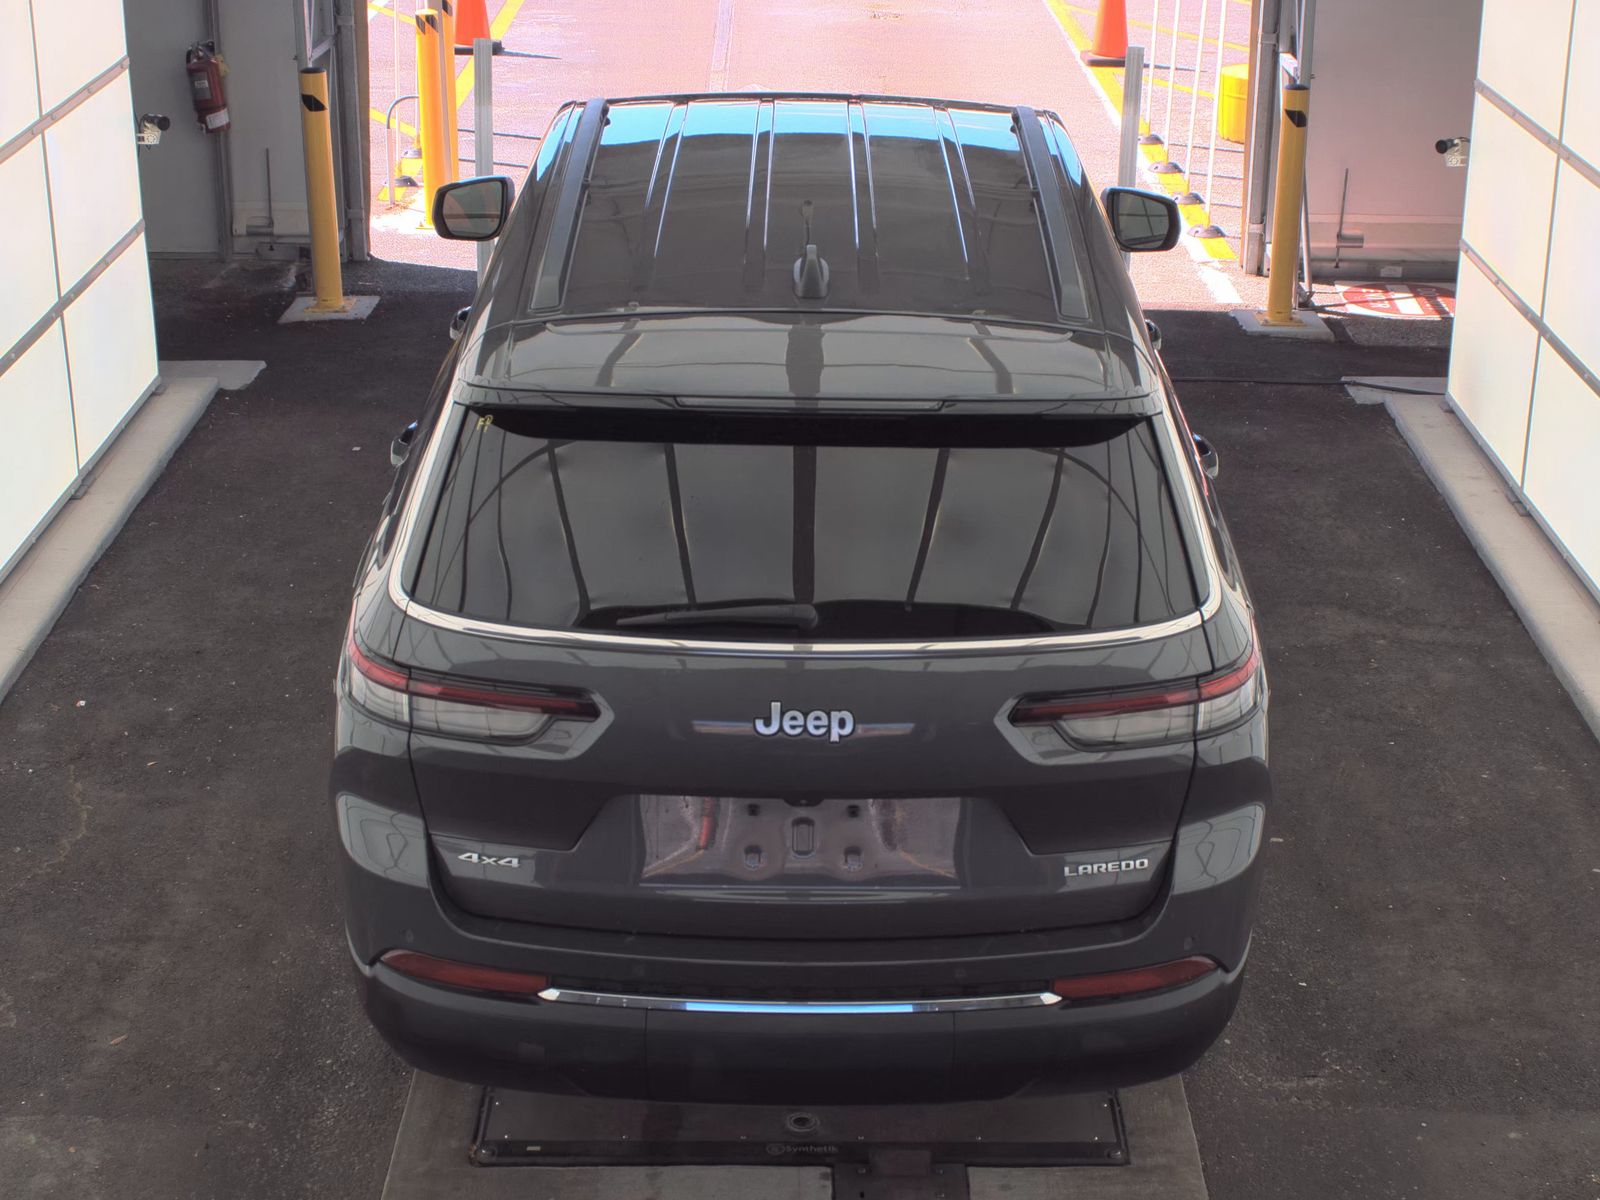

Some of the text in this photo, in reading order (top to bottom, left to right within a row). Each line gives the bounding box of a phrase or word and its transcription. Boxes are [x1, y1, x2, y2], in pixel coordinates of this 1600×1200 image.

[755, 701, 854, 742] Jeep
[458, 852, 520, 868] 4x4
[1064, 858, 1149, 877] LAREDO
